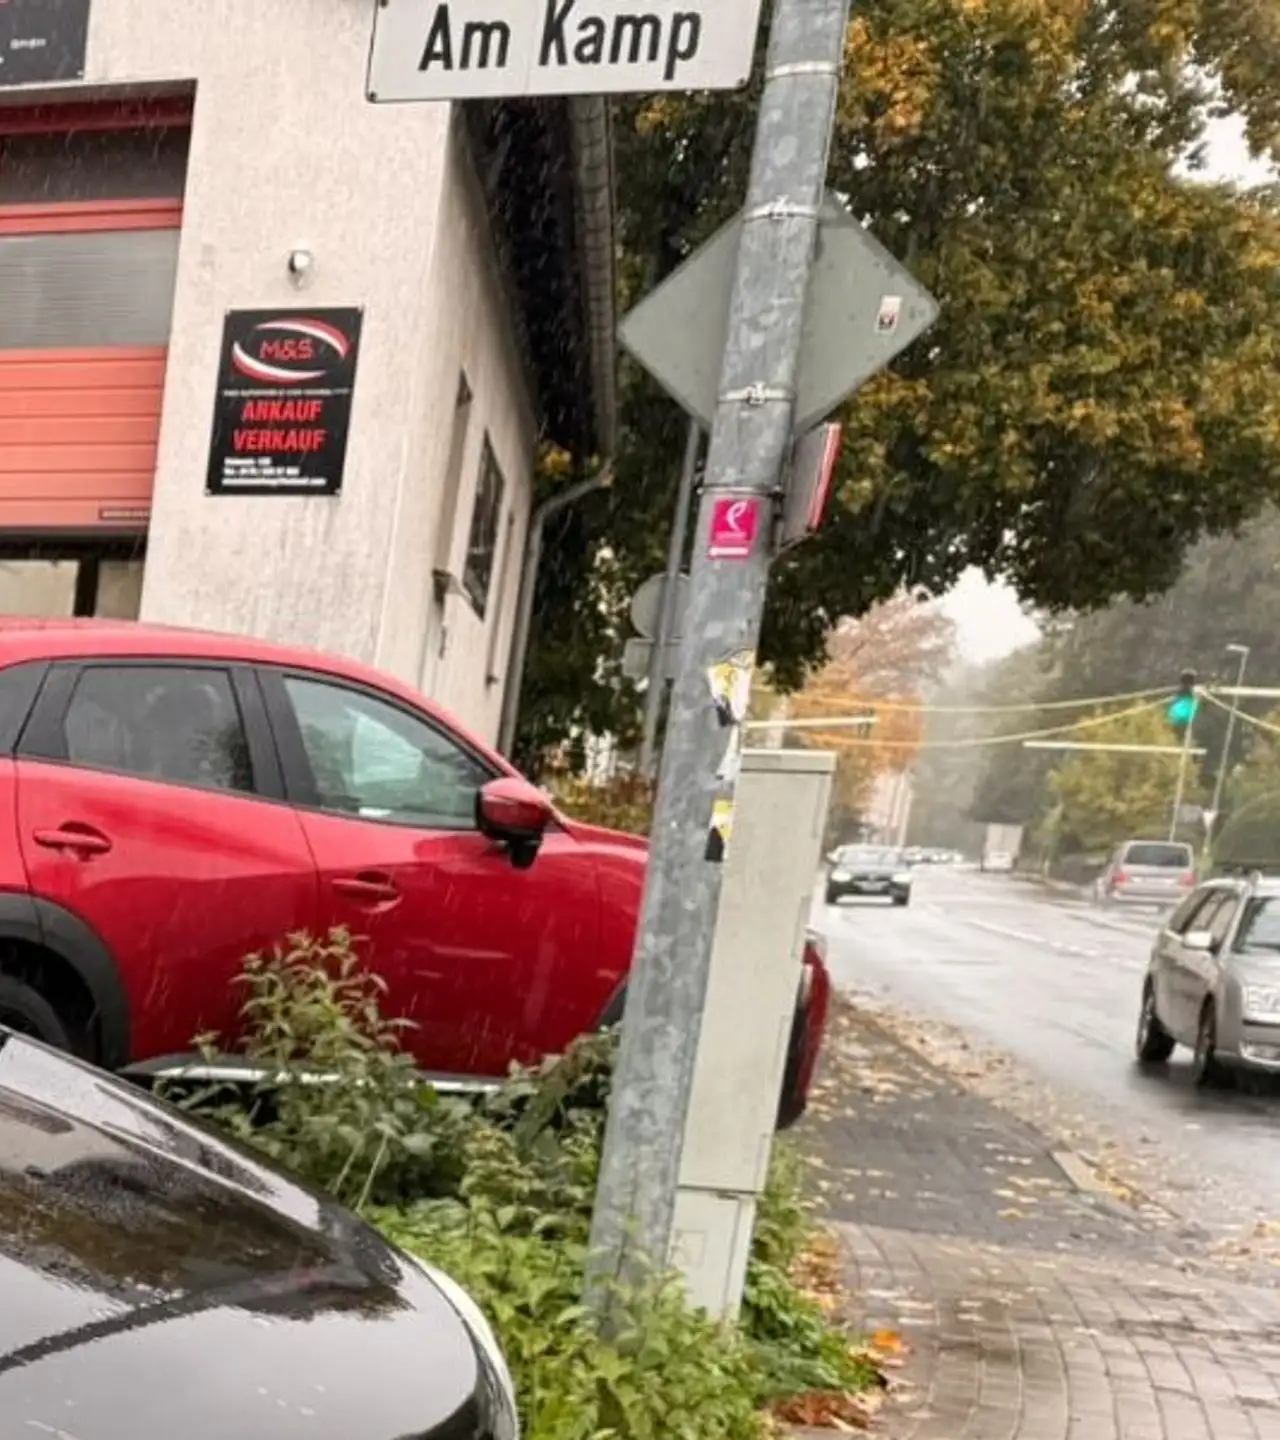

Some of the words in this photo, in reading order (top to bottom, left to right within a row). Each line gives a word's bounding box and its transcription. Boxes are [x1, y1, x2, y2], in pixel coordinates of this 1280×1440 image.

[418, 3, 511, 71] Am
[538, 0, 701, 81] Kamp
[259, 338, 314, 360] M&S
[242, 400, 323, 421] ANKAUF
[233, 428, 328, 451] VERKAUF
